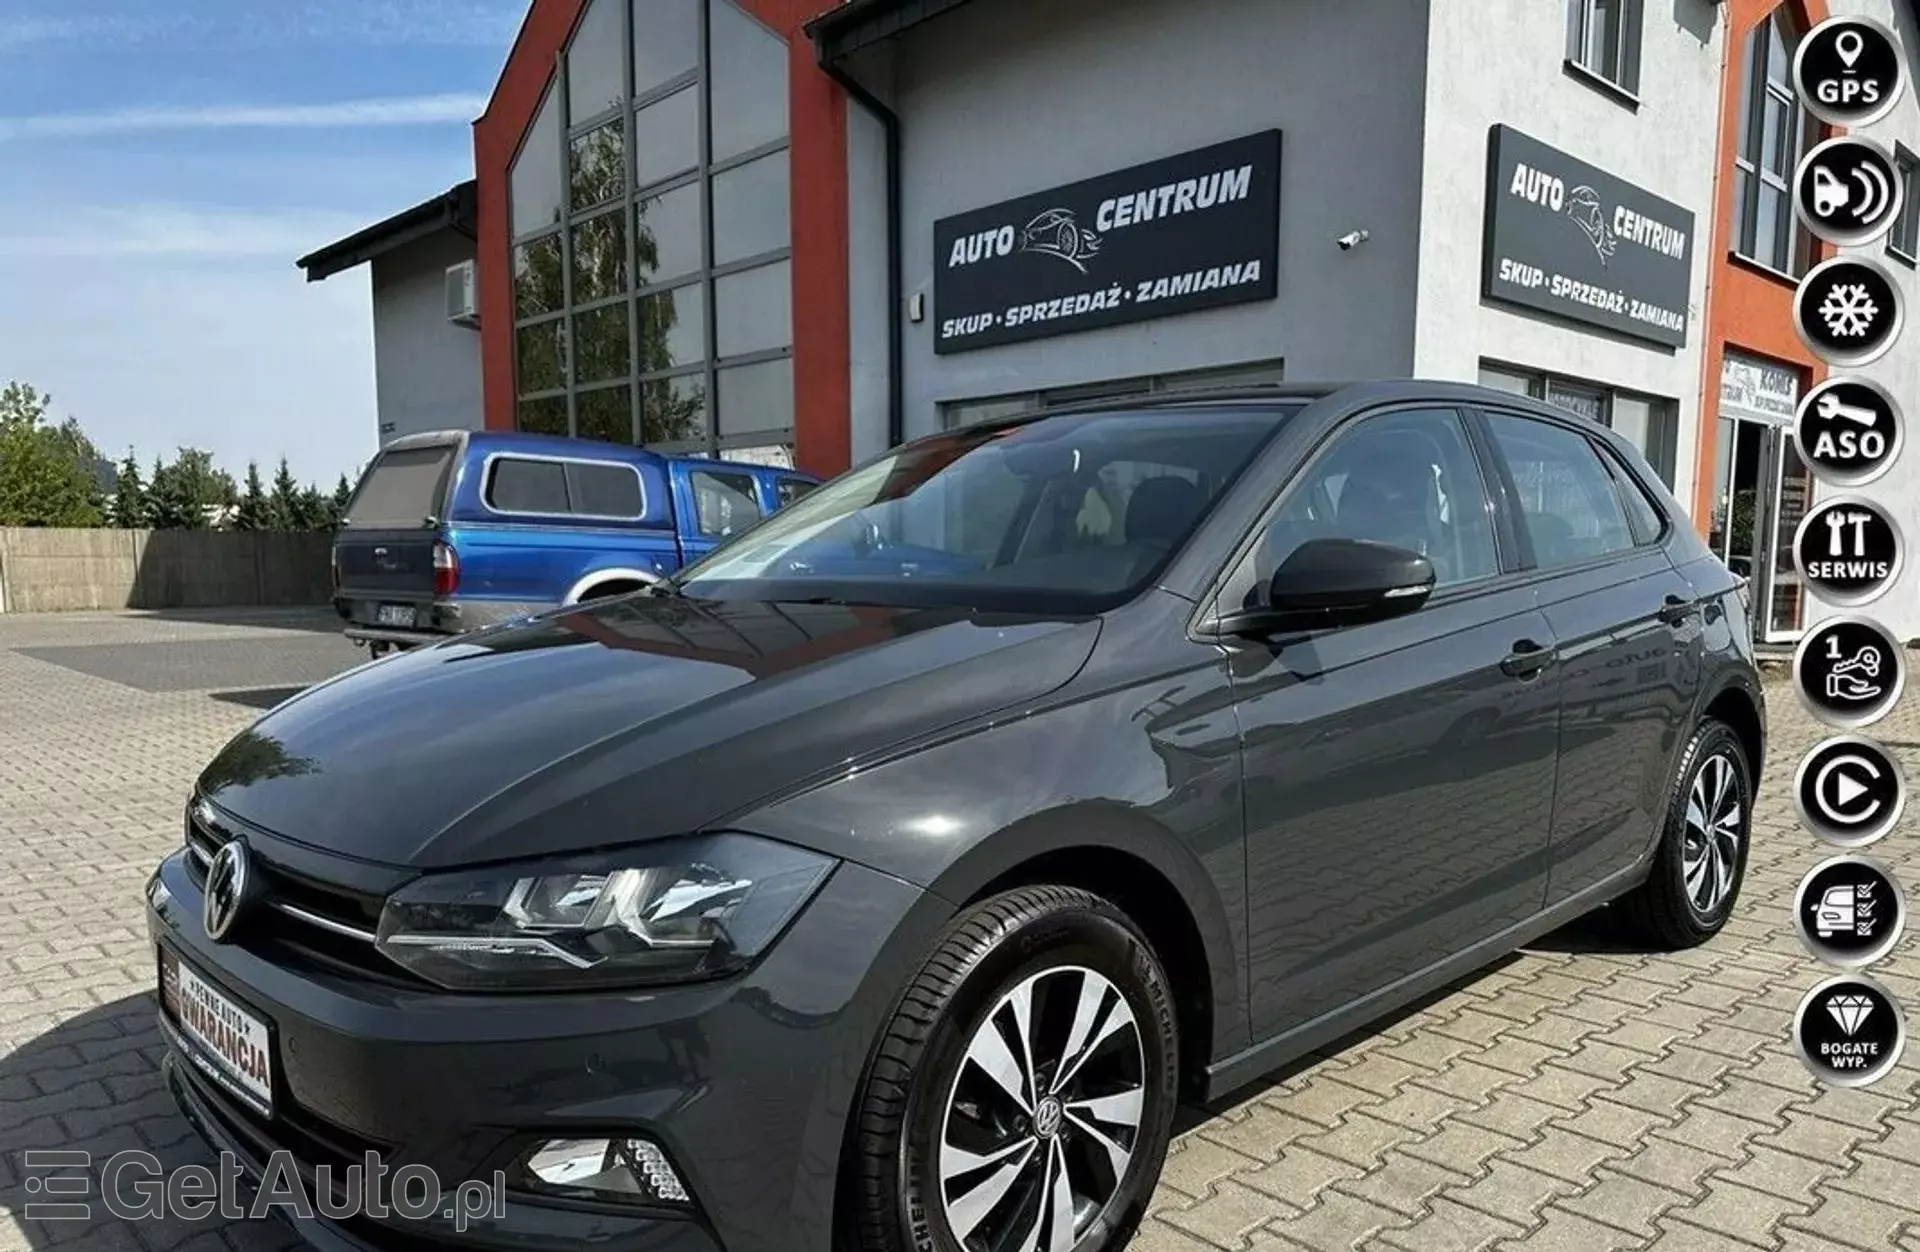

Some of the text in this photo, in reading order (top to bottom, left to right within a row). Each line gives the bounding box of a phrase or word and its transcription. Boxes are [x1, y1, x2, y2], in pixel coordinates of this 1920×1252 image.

[948, 164, 1253, 268] AUTO CENTRUM
[1510, 163, 1686, 260] AUTO CENTRUM
[942, 260, 1261, 338] SKUP SPRZEDAŻ ZAMIANA
[1499, 258, 1684, 332] SKUP SPRZEDAŻ ZAMIANA
